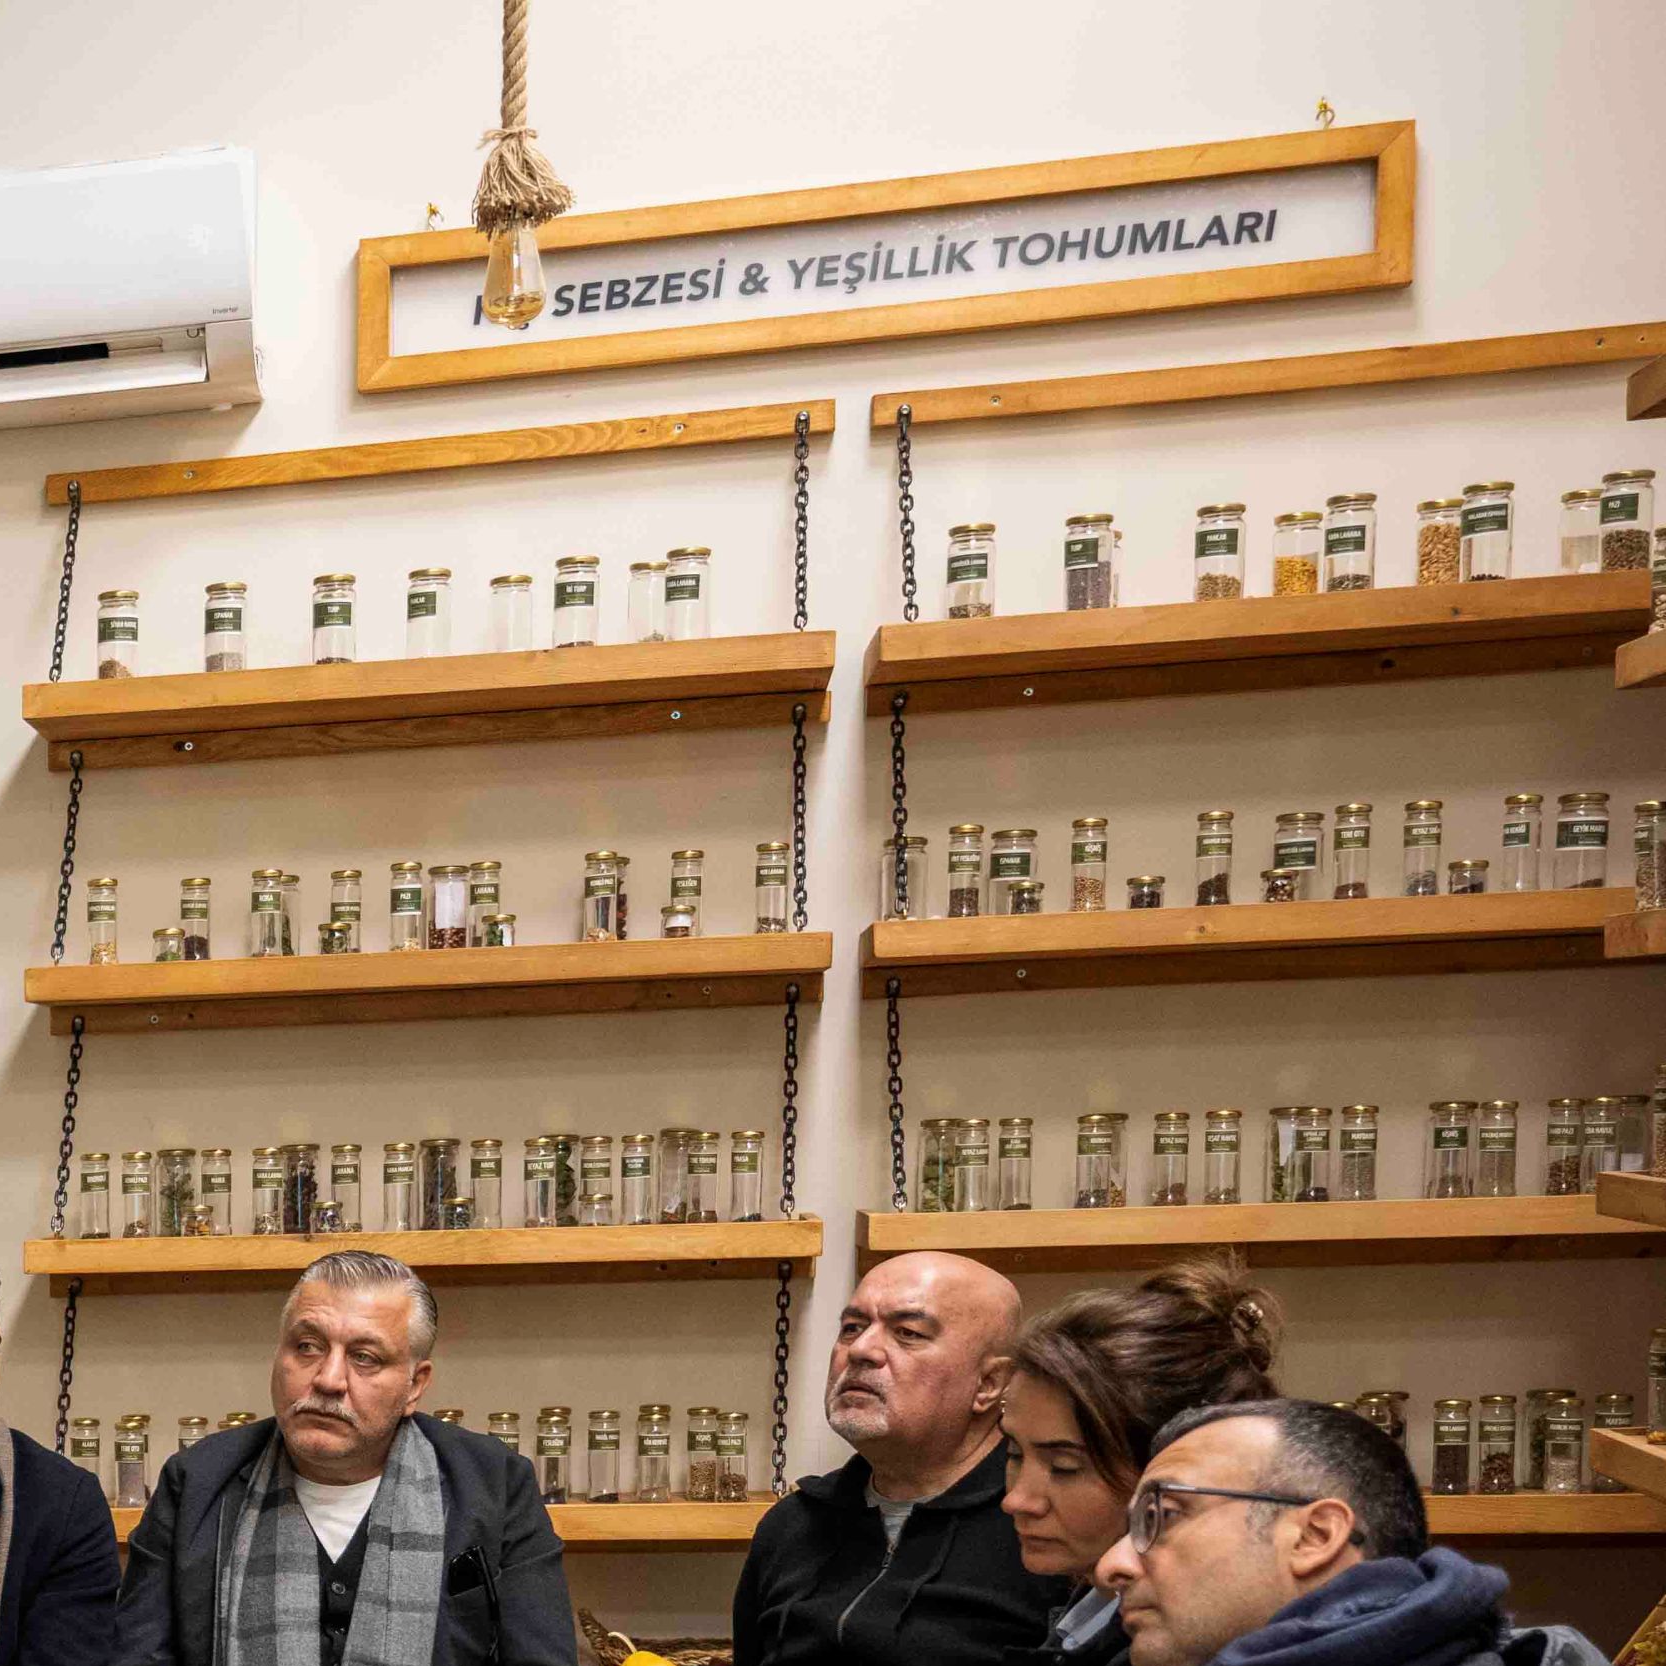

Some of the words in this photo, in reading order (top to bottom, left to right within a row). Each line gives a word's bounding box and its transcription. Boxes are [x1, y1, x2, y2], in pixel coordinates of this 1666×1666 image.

[552, 257, 726, 319] SEBZESİ
[737, 263, 770, 297] &
[788, 232, 977, 295] YEŞİLLİK
[991, 210, 1280, 272] TOHUMLARI
